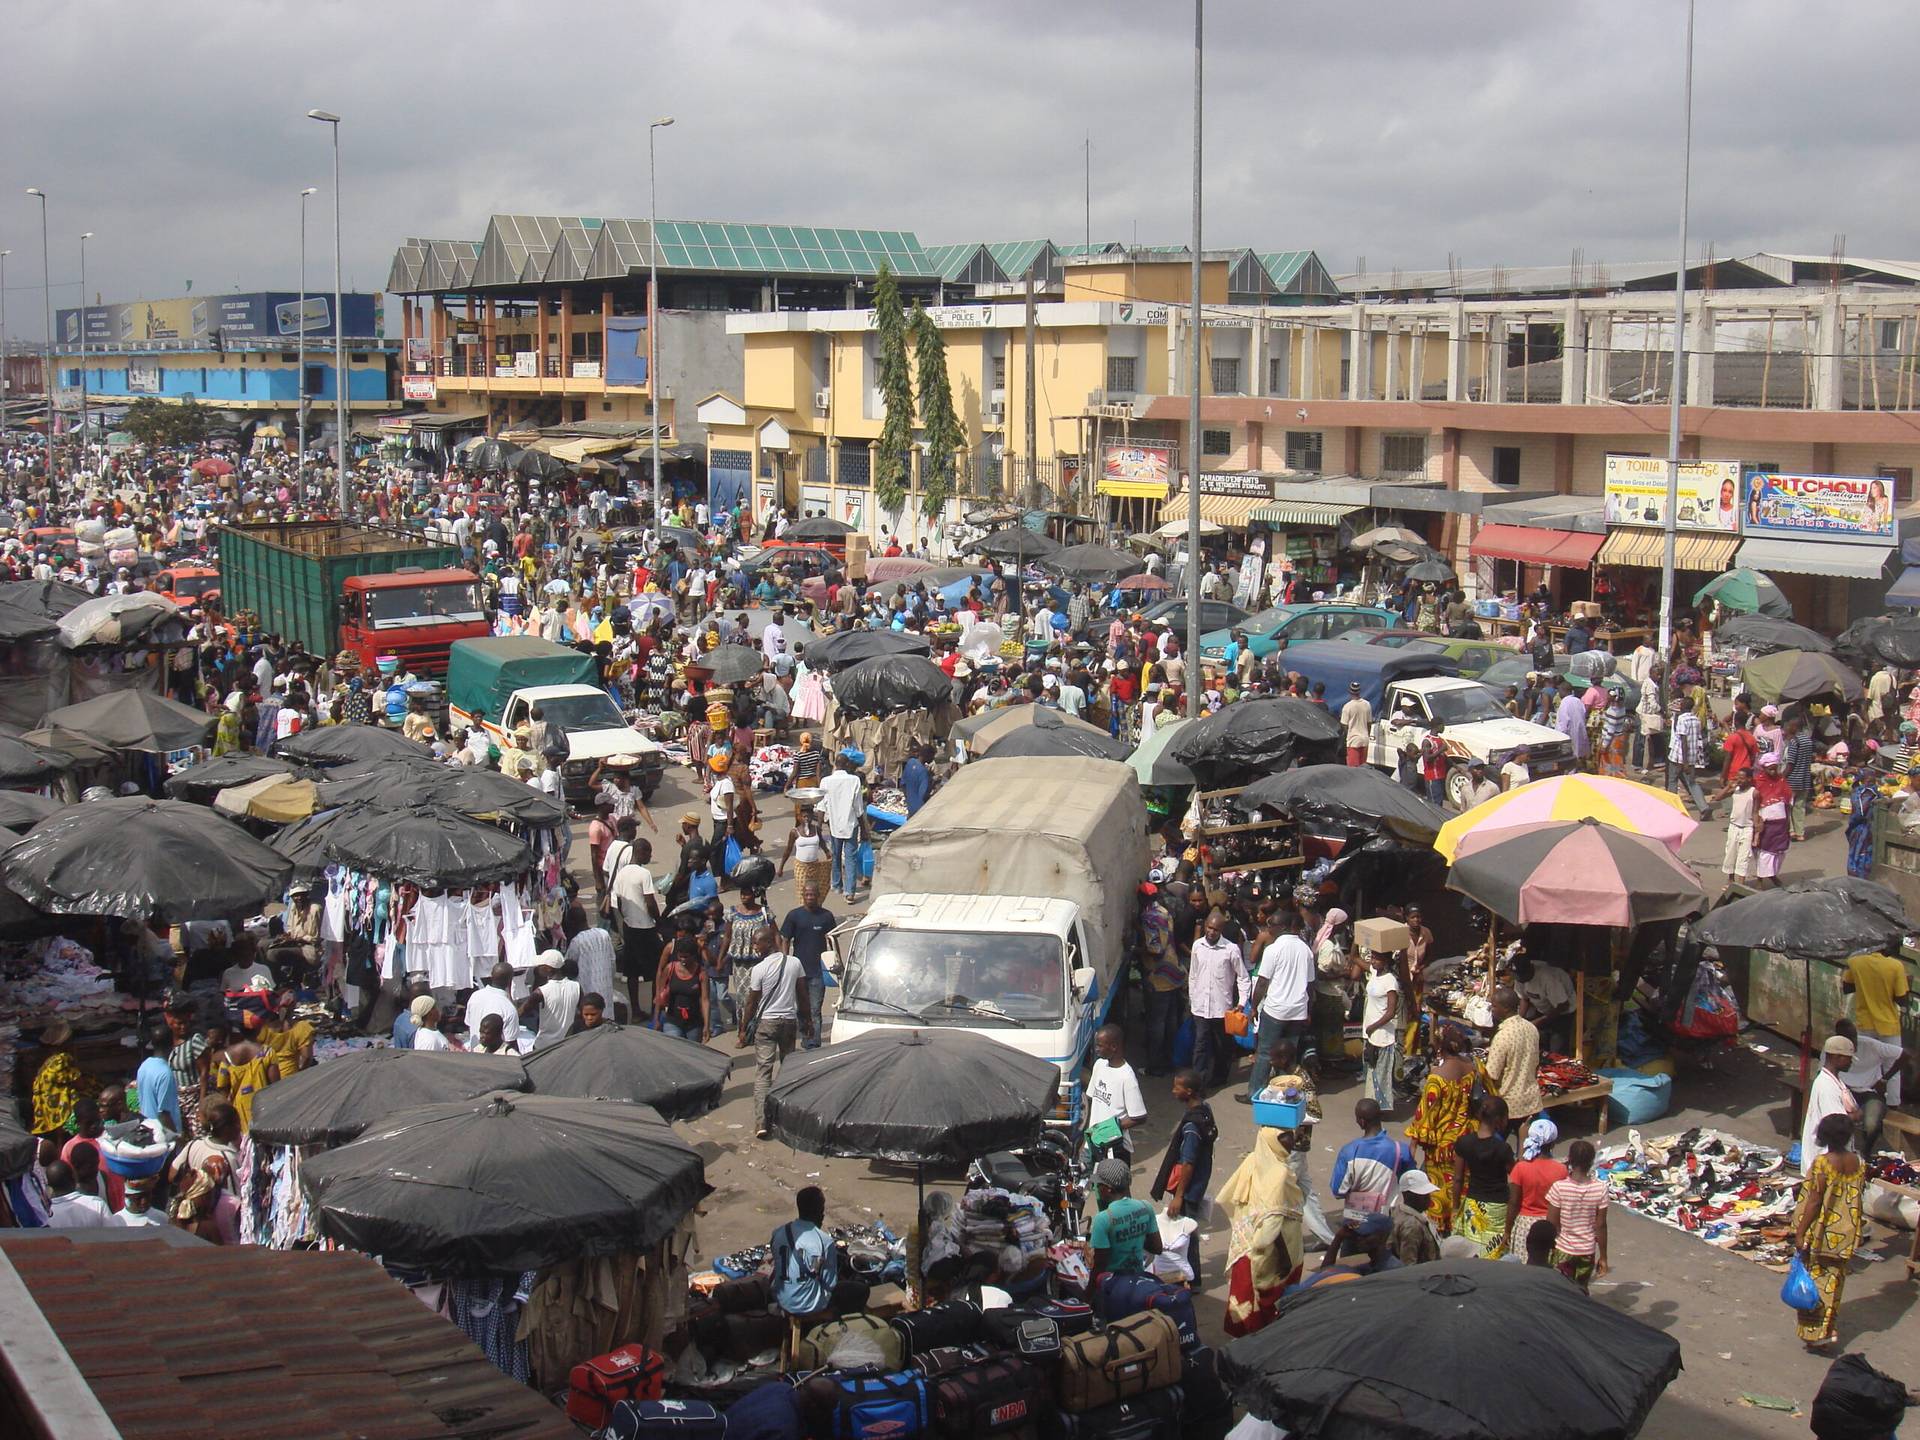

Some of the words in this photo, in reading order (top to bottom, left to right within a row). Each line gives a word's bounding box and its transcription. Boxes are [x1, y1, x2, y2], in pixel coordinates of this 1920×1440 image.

[951, 313, 975, 321] POLICE
[1626, 460, 1660, 473] TONIA
[1767, 478, 1868, 495] PITCHOU
[760, 489, 774, 497] POLICE
[1818, 489, 1866, 500] Boutique
[997, 1400, 1027, 1423] NBA
